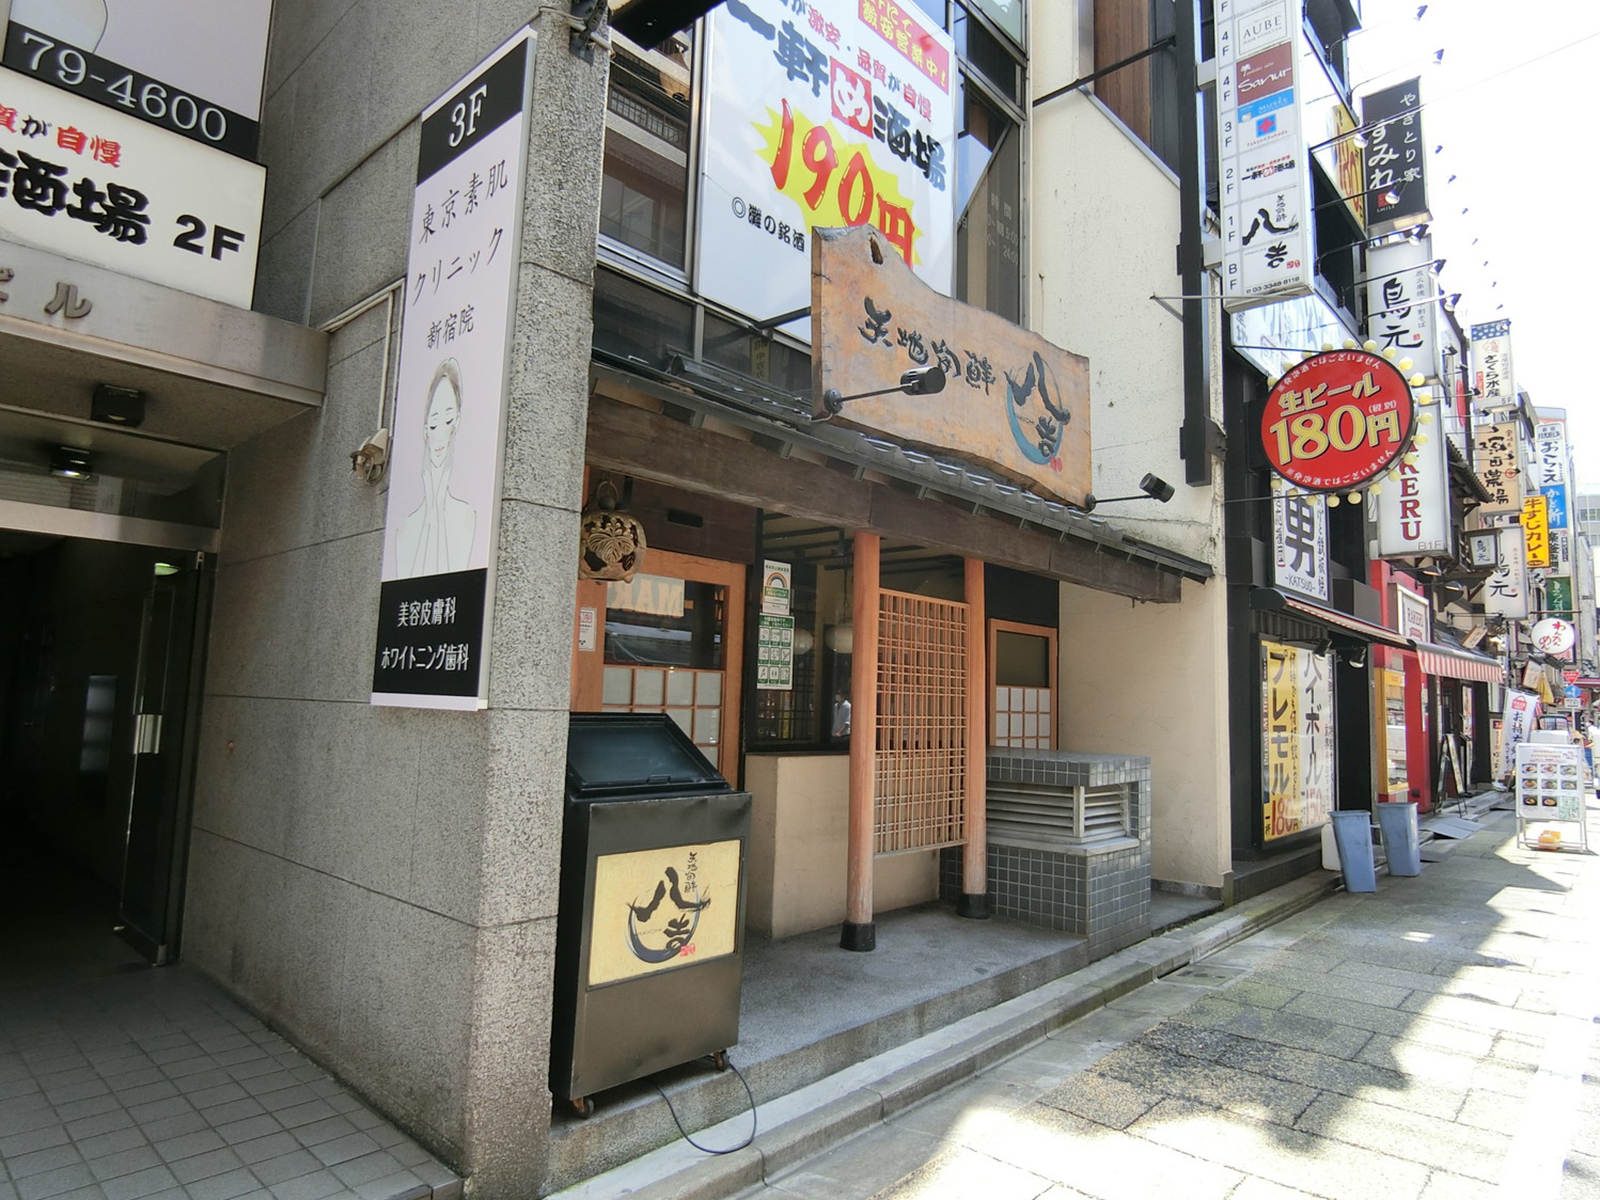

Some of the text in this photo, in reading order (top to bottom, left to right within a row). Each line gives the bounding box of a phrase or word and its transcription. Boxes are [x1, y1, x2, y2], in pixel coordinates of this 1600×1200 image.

[1243, 13, 1283, 40] AUBE
[23, 32, 227, 142] 79-4600
[779, 0, 932, 122] が激安・品質が自慢
[1238, 66, 1292, 93] Sanur
[448, 84, 488, 148] 3F
[726, 0, 946, 192] 一軒め酒場
[418, 159, 509, 245] 東京素肌
[172, 213, 246, 262] 2F
[412, 227, 504, 307] クリニック
[426, 304, 475, 350] 新宿院
[1378, 277, 1424, 352] 鳥元
[1277, 371, 1381, 418] 生ビール
[1484, 354, 1500, 398] さくら水産
[1269, 404, 1401, 467] 180円
[397, 596, 457, 628] 美容皮膚科
[381, 643, 470, 671] ホワイトニング歯科
[1268, 650, 1291, 797] プレモル
[1303, 651, 1325, 786] ハイボール
